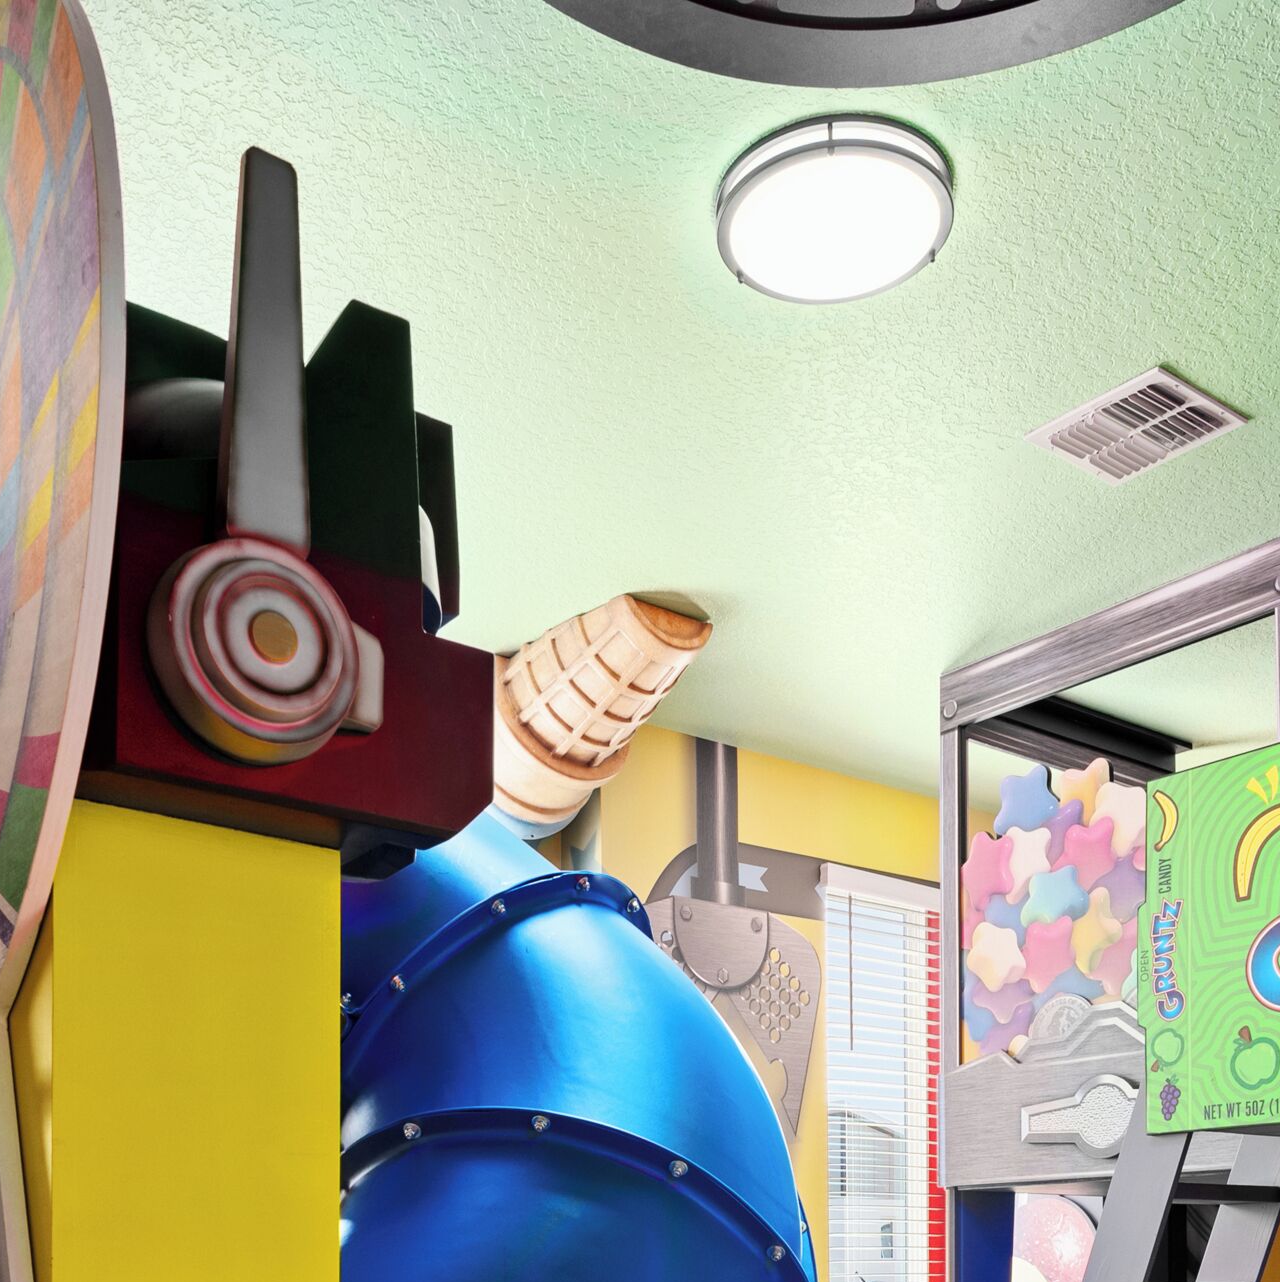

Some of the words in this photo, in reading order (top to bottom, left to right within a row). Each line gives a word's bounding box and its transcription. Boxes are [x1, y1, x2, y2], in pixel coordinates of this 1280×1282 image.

[1158, 857, 1173, 895] CANDY
[1140, 950, 1150, 982] OPEN
[1151, 898, 1186, 1022] GRUNTZ
[1204, 1103, 1223, 1120] NET
[1226, 1101, 1242, 1118] WT
